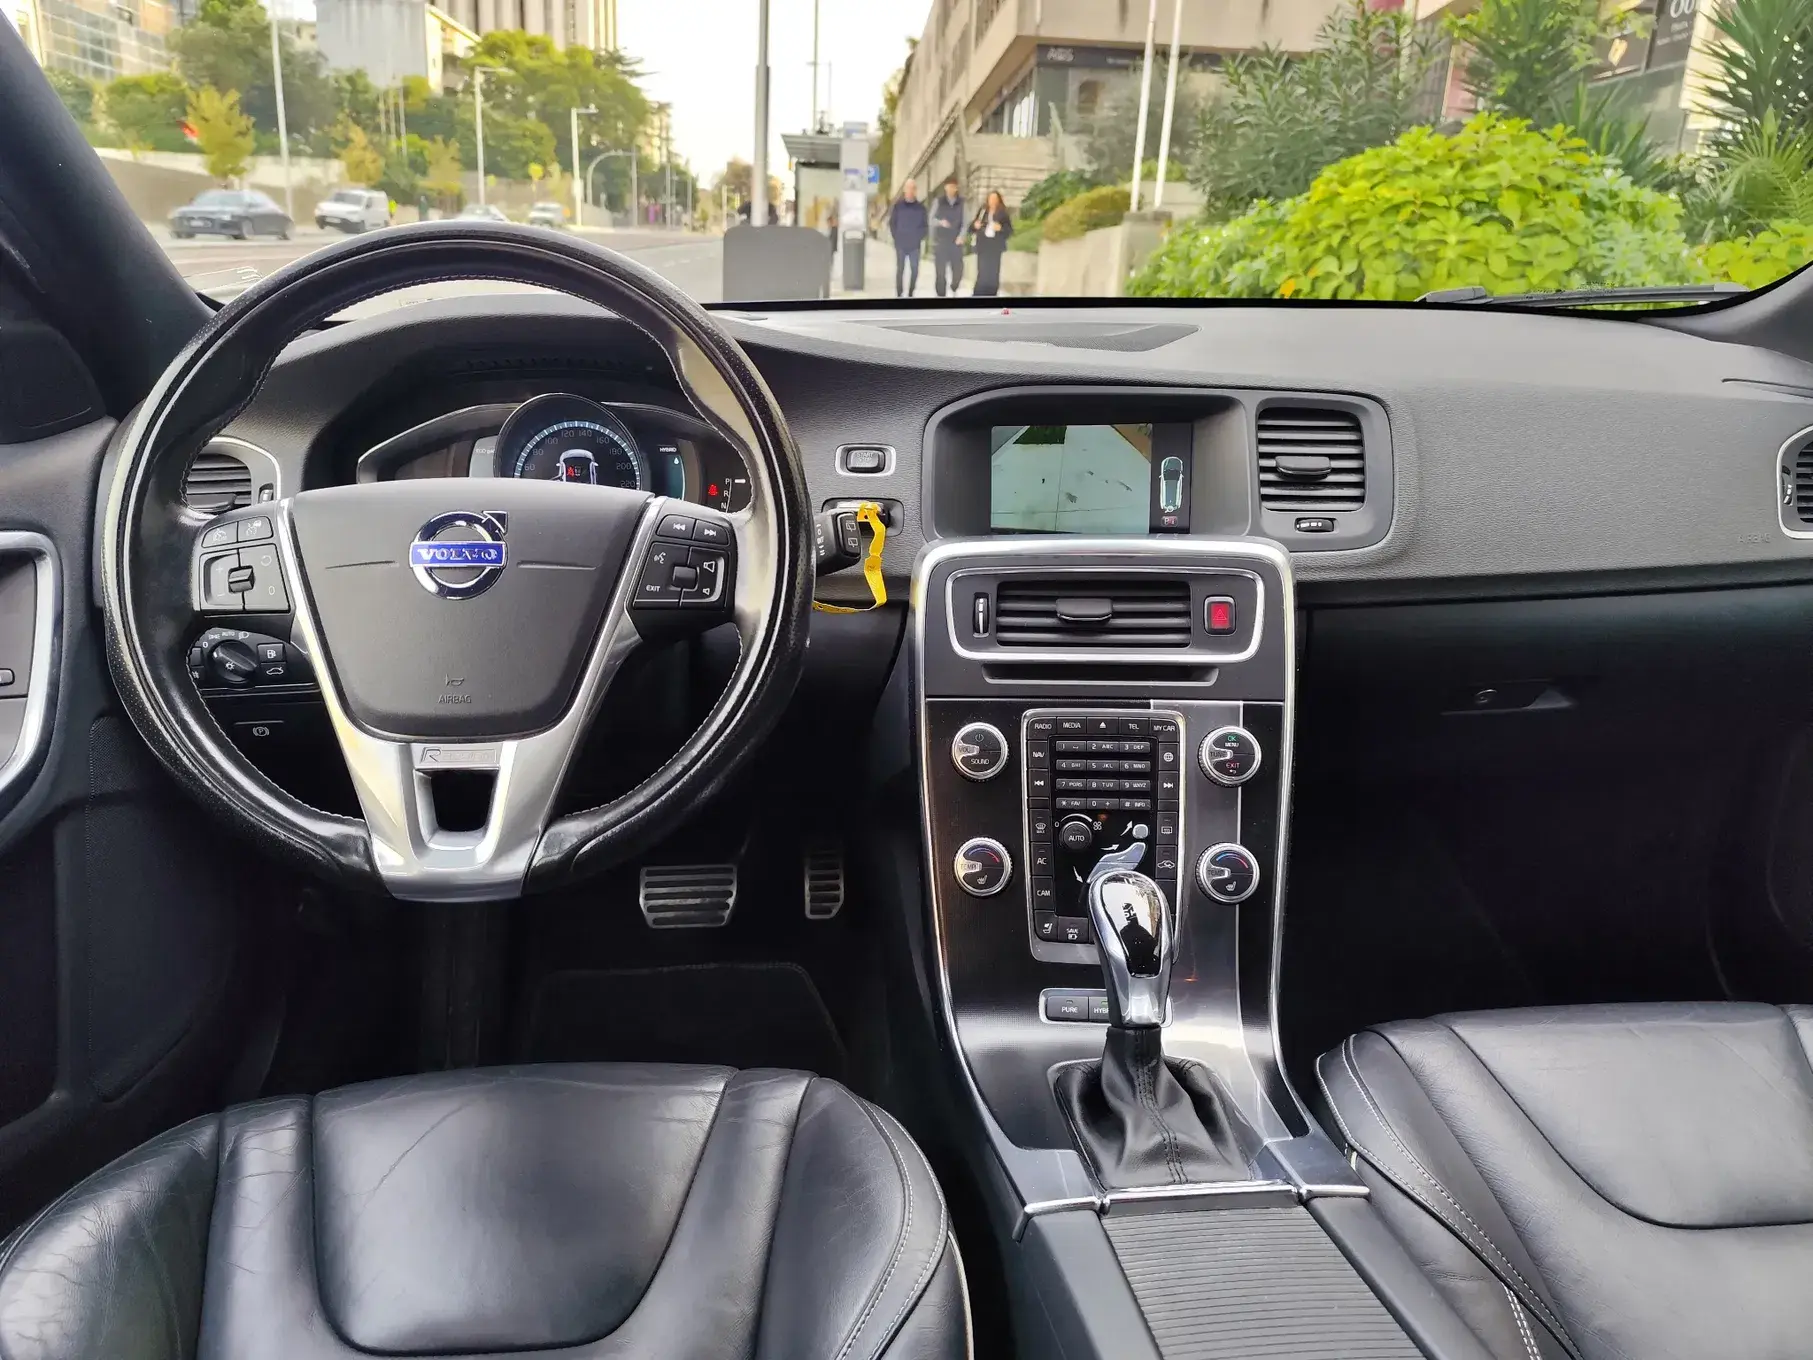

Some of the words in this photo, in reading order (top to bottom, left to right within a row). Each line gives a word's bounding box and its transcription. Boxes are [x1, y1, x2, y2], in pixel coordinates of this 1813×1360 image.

[417, 548, 498, 561] VOLVO
[646, 584, 661, 592] EXIT
[438, 694, 472, 704] AIRBAG
[1037, 857, 1047, 865] AC
